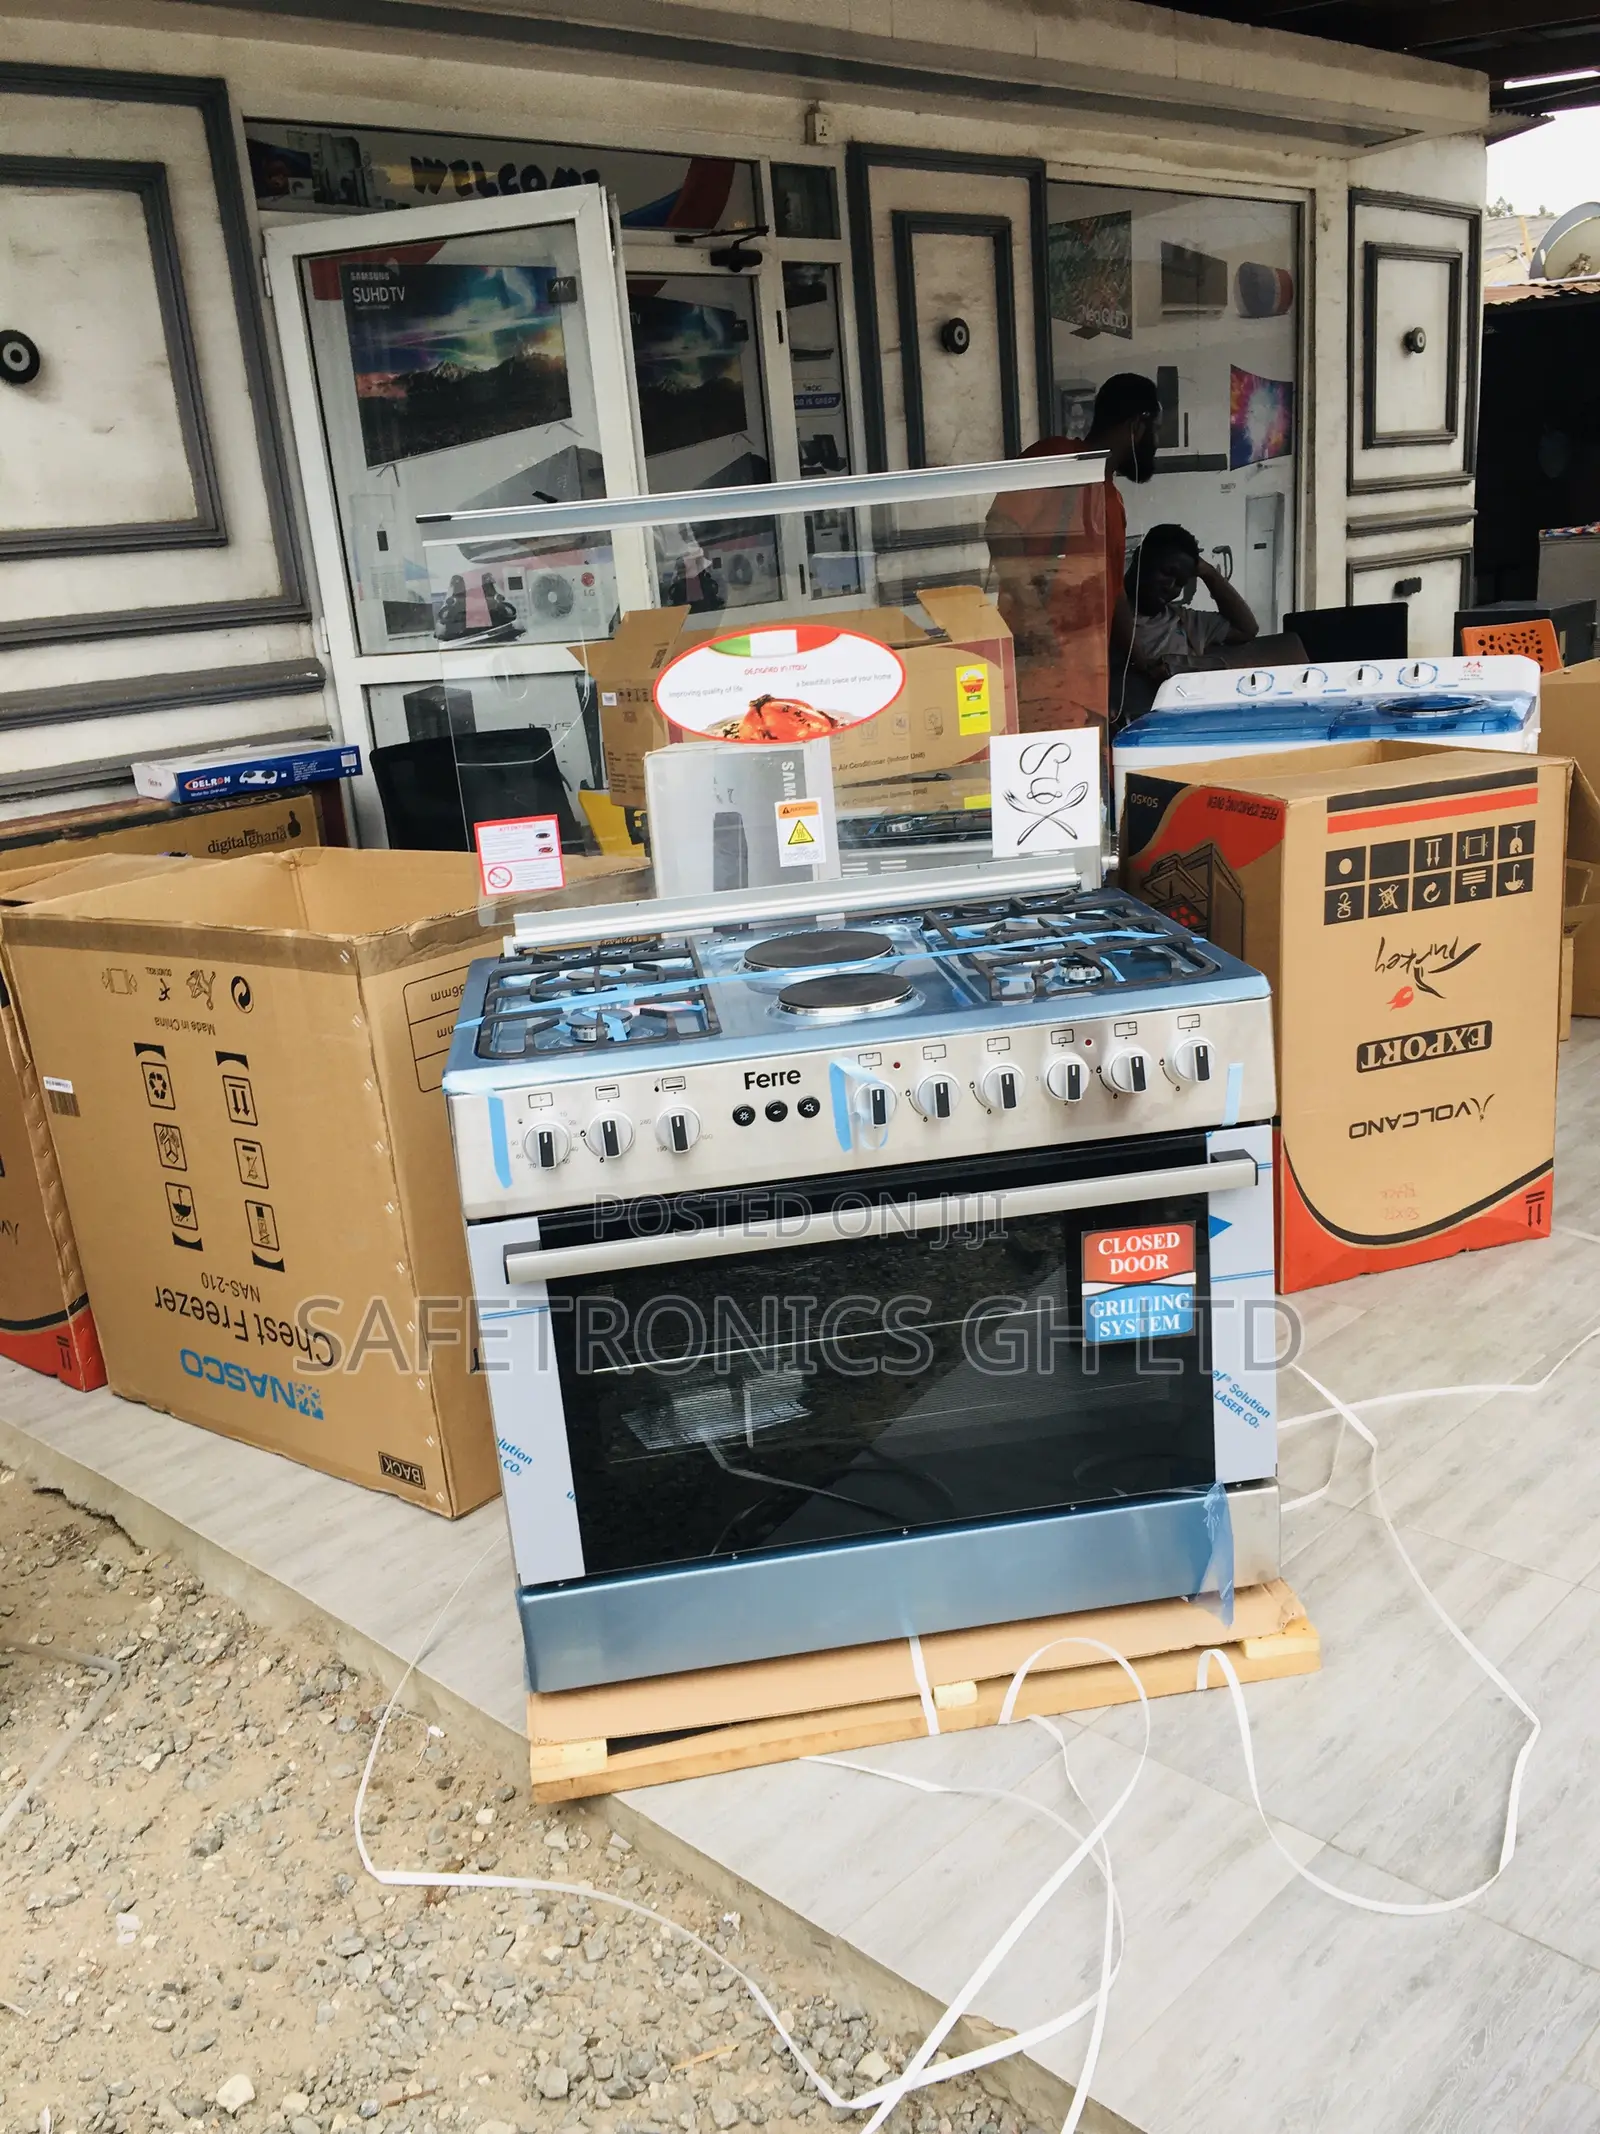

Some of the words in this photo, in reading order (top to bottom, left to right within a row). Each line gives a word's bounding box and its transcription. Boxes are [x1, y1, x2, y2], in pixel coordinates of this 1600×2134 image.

[351, 272, 390, 281] SAMSUNG
[583, 589, 596, 597] LG
[838, 764, 848, 772] Air
[849, 759, 885, 770] Conditioner
[192, 776, 231, 789] DELRON
[1374, 936, 1482, 999] Turkey
[154, 1016, 180, 1030] China
[191, 1022, 216, 1036] Made
[1360, 1023, 1488, 1070] EXPORT
[744, 1069, 801, 1090] Ferre
[1098, 1232, 1180, 1255] CLOSED
[1110, 1254, 1169, 1275] DOOR
[201, 1272, 261, 1302] NAS-210
[154, 1285, 249, 1342] Freezer
[1089, 1293, 1190, 1318] GRILLING
[1100, 1314, 1181, 1337] SYSTEM
[257, 1313, 335, 1367] Chest
[180, 1348, 297, 1410] NASCO
[1214, 1390, 1244, 1416] LASER
[1229, 1383, 1271, 1419] Solution
[498, 1438, 533, 1465] lution
[382, 1458, 422, 1484] BACK
